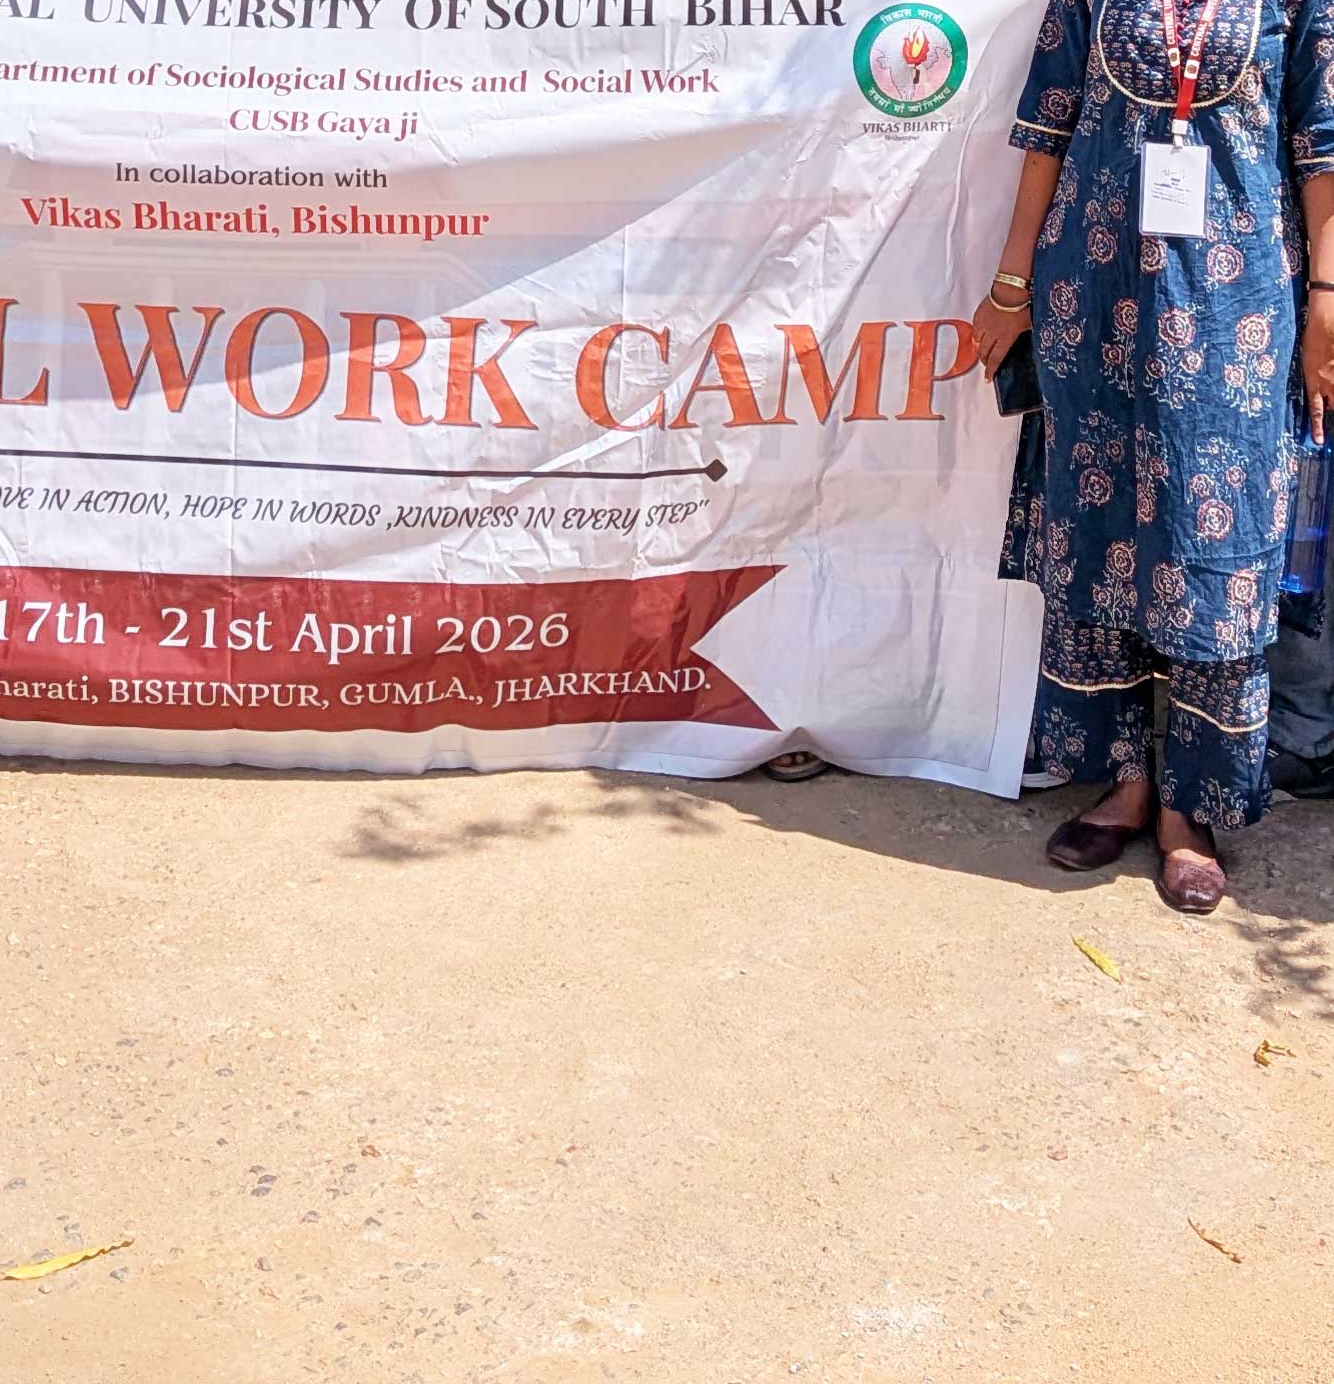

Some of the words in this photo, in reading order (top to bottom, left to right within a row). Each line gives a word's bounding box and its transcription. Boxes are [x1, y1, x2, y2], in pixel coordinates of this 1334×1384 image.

[1163, 10, 1177, 45] CENTRAL
[1188, 20, 1209, 57] CENTRAL
[127, 62, 162, 87] of
[165, 62, 347, 97] Sociological
[354, 67, 463, 94] Studies
[470, 68, 527, 93] and
[543, 68, 632, 94] Social
[640, 68, 721, 94] Work
[229, 108, 309, 133] CUSB
[862, 121, 901, 134] VIKAS
[903, 121, 952, 132] BHARTI
[115, 162, 141, 184] In
[149, 162, 325, 188] collaboration
[334, 167, 387, 189] with
[21, 196, 122, 231] Vikas
[132, 200, 280, 238] Bharati,
[291, 204, 490, 242] Bishunpur
[77, 302, 538, 431] WORK
[574, 317, 981, 431] CAMP
[40, 487, 73, 512] IN
[75, 490, 170, 521] ACTION,
[179, 493, 244, 519] HOPE
[251, 497, 283, 521] IN
[288, 498, 384, 527] WORDS
[523, 505, 557, 532] IN
[561, 505, 638, 537] EVERY
[158, 606, 273, 652] 21st
[290, 611, 412, 666] April
[436, 612, 571, 655] 2026
[108, 679, 330, 710] BISHUNPUR,
[492, 665, 713, 708] JHARKHAND.
